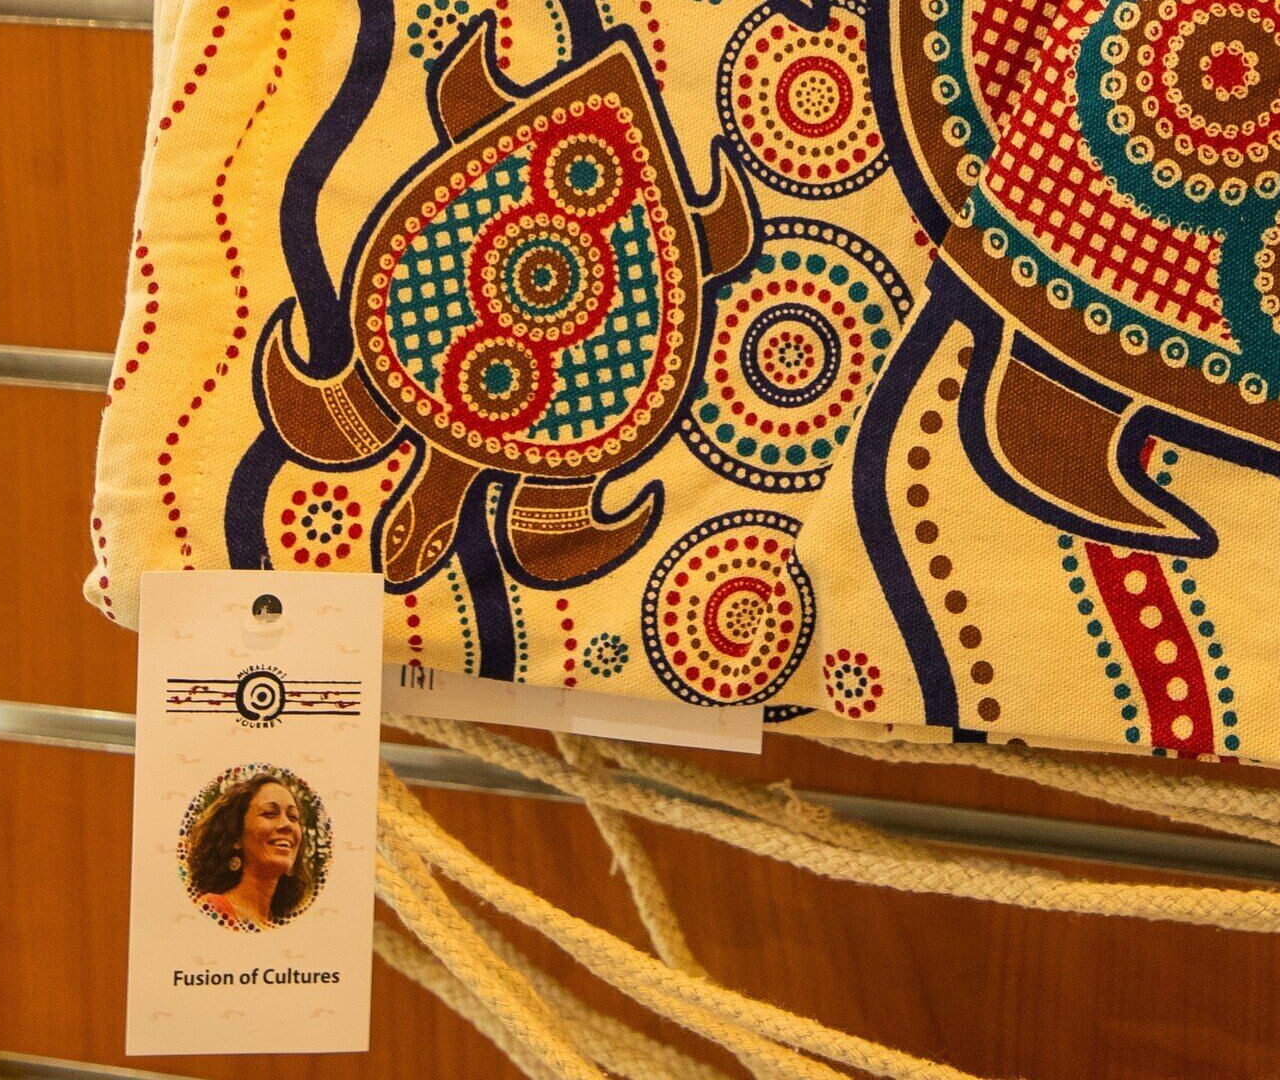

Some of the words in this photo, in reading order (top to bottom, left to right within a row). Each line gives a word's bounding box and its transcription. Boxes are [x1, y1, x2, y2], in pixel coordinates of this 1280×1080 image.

[173, 970, 234, 986] Fusion
[239, 968, 259, 985] of
[263, 968, 340, 984] Cultures
